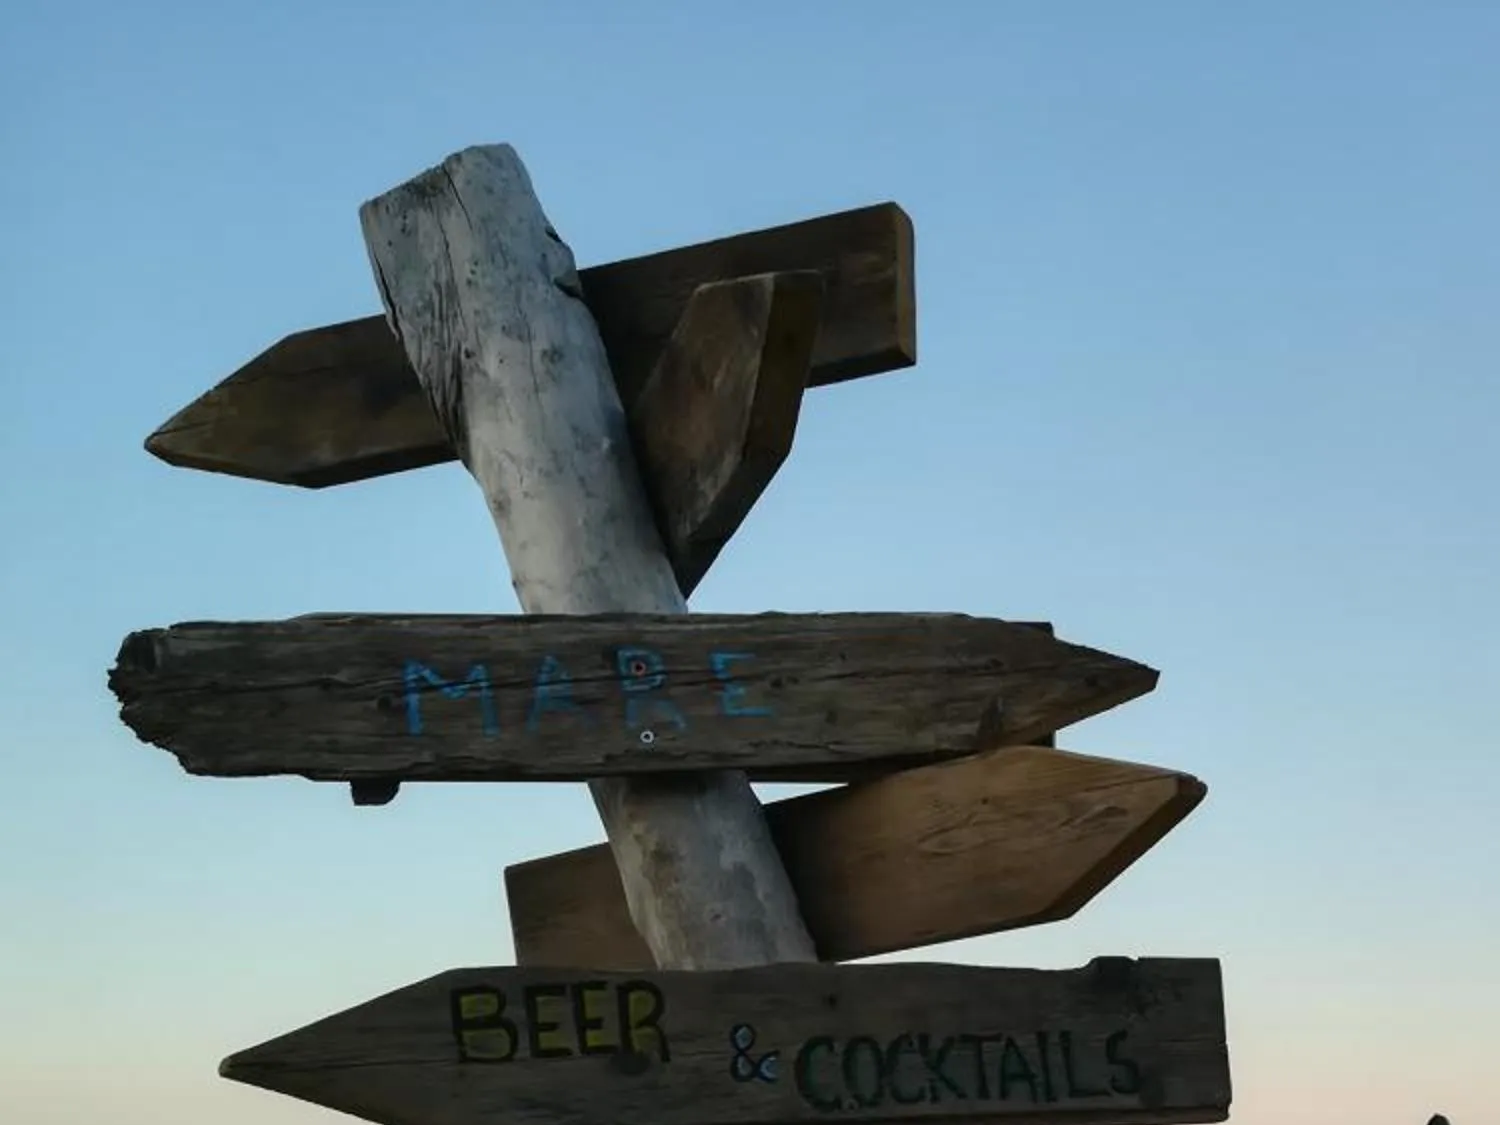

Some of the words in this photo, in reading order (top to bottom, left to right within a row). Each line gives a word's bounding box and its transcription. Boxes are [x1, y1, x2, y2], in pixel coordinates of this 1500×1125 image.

[402, 646, 775, 738] MARE
[451, 980, 670, 1064] BEER
[729, 1022, 781, 1084] &
[798, 1028, 1142, 1111] COCKTAILS
